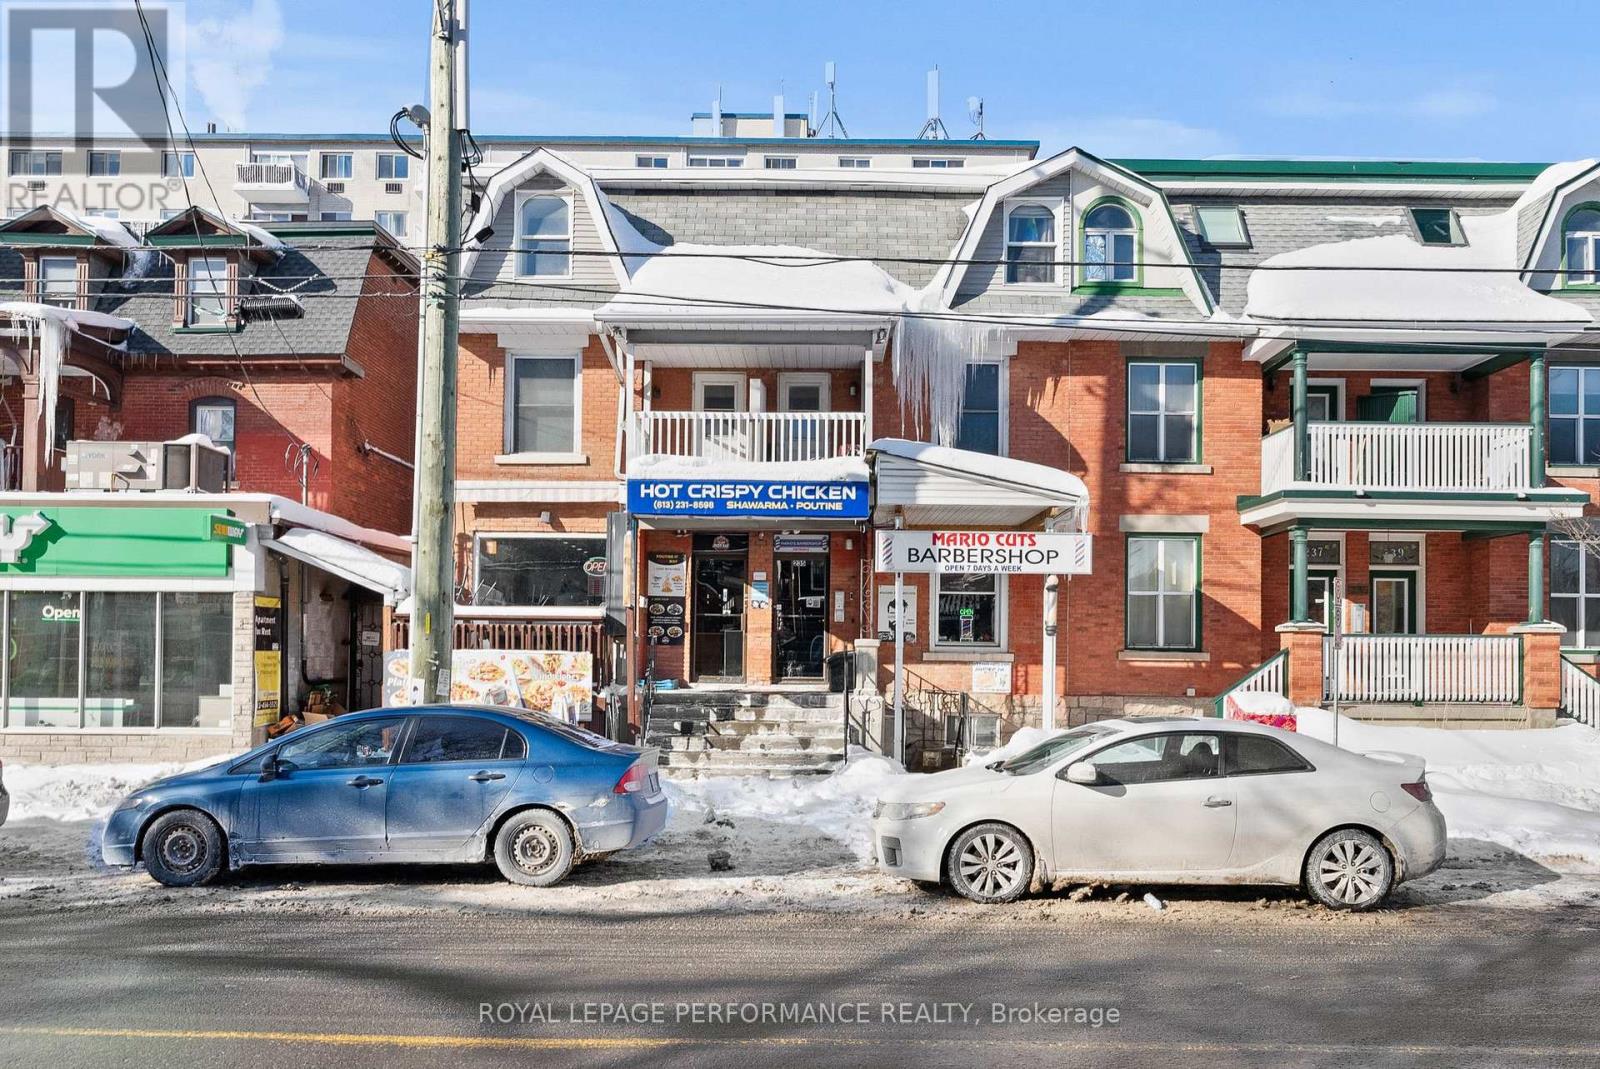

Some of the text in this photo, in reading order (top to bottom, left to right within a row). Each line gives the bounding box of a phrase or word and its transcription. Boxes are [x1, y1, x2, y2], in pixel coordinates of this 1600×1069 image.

[640, 483, 857, 500] HOT CRISPY CHICKEN
[653, 499, 674, 510] (613)
[726, 501, 788, 509] SHAWARMA
[796, 502, 843, 510] POUTINE
[932, 532, 1037, 547] MARIO CUTS
[907, 547, 1059, 565] BARBERSHOP
[42, 605, 81, 620] Open
